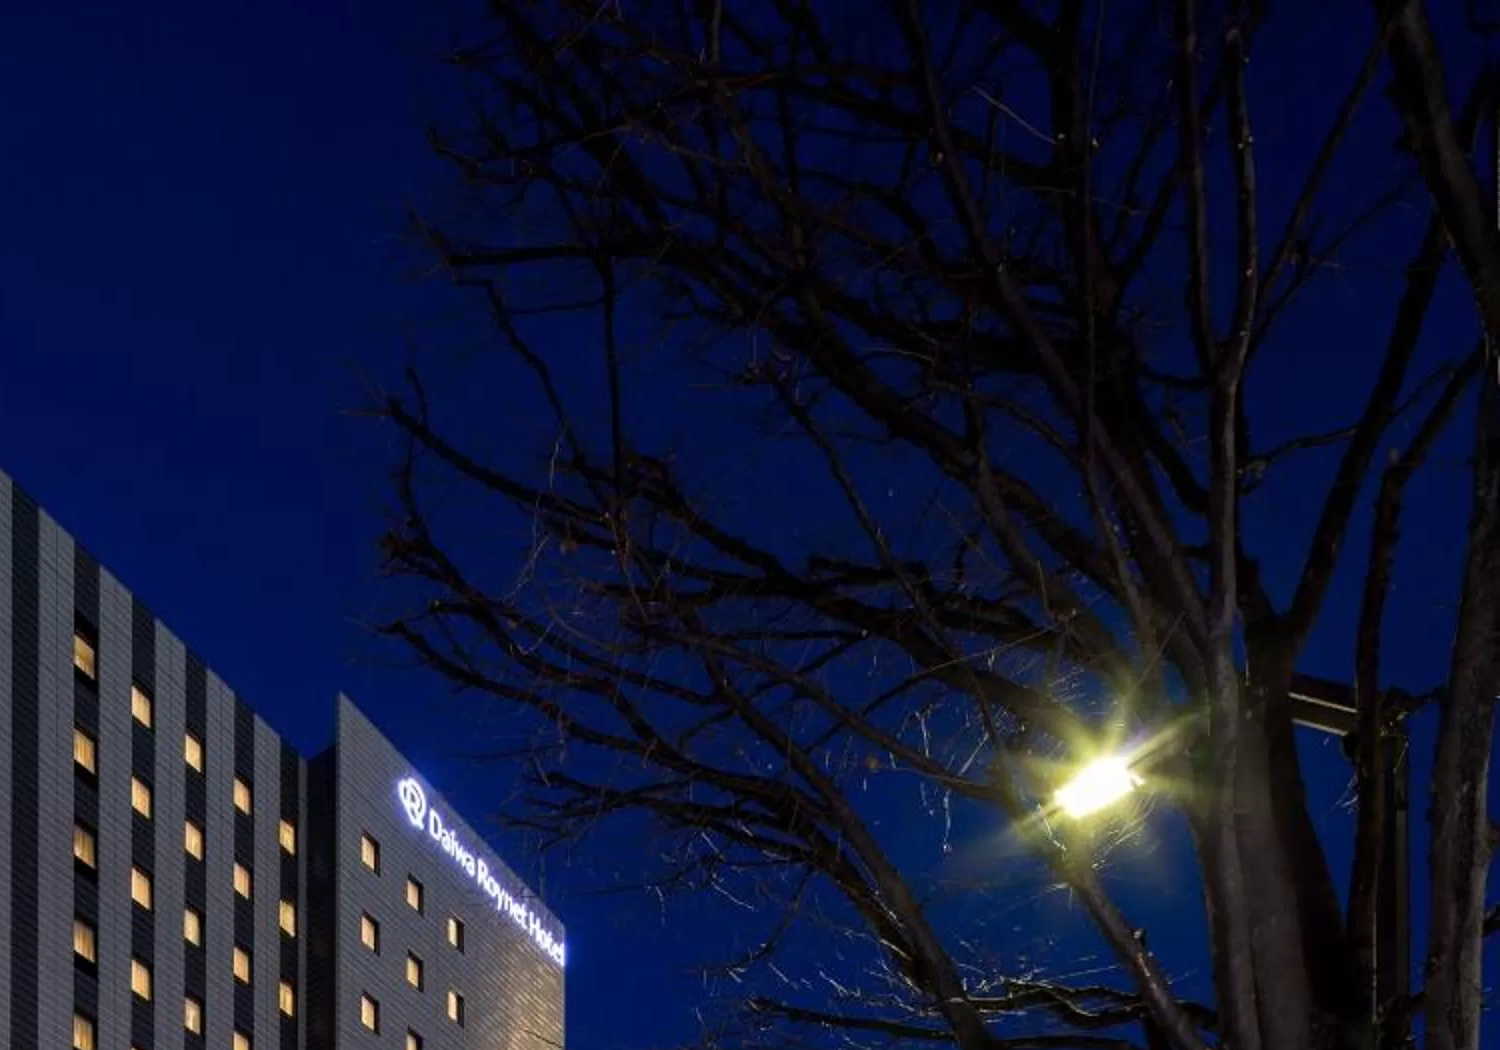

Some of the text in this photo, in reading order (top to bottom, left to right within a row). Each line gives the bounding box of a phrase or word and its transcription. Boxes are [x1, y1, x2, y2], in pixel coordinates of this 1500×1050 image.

[429, 808, 565, 967] Daiwa Roynet Hotel
